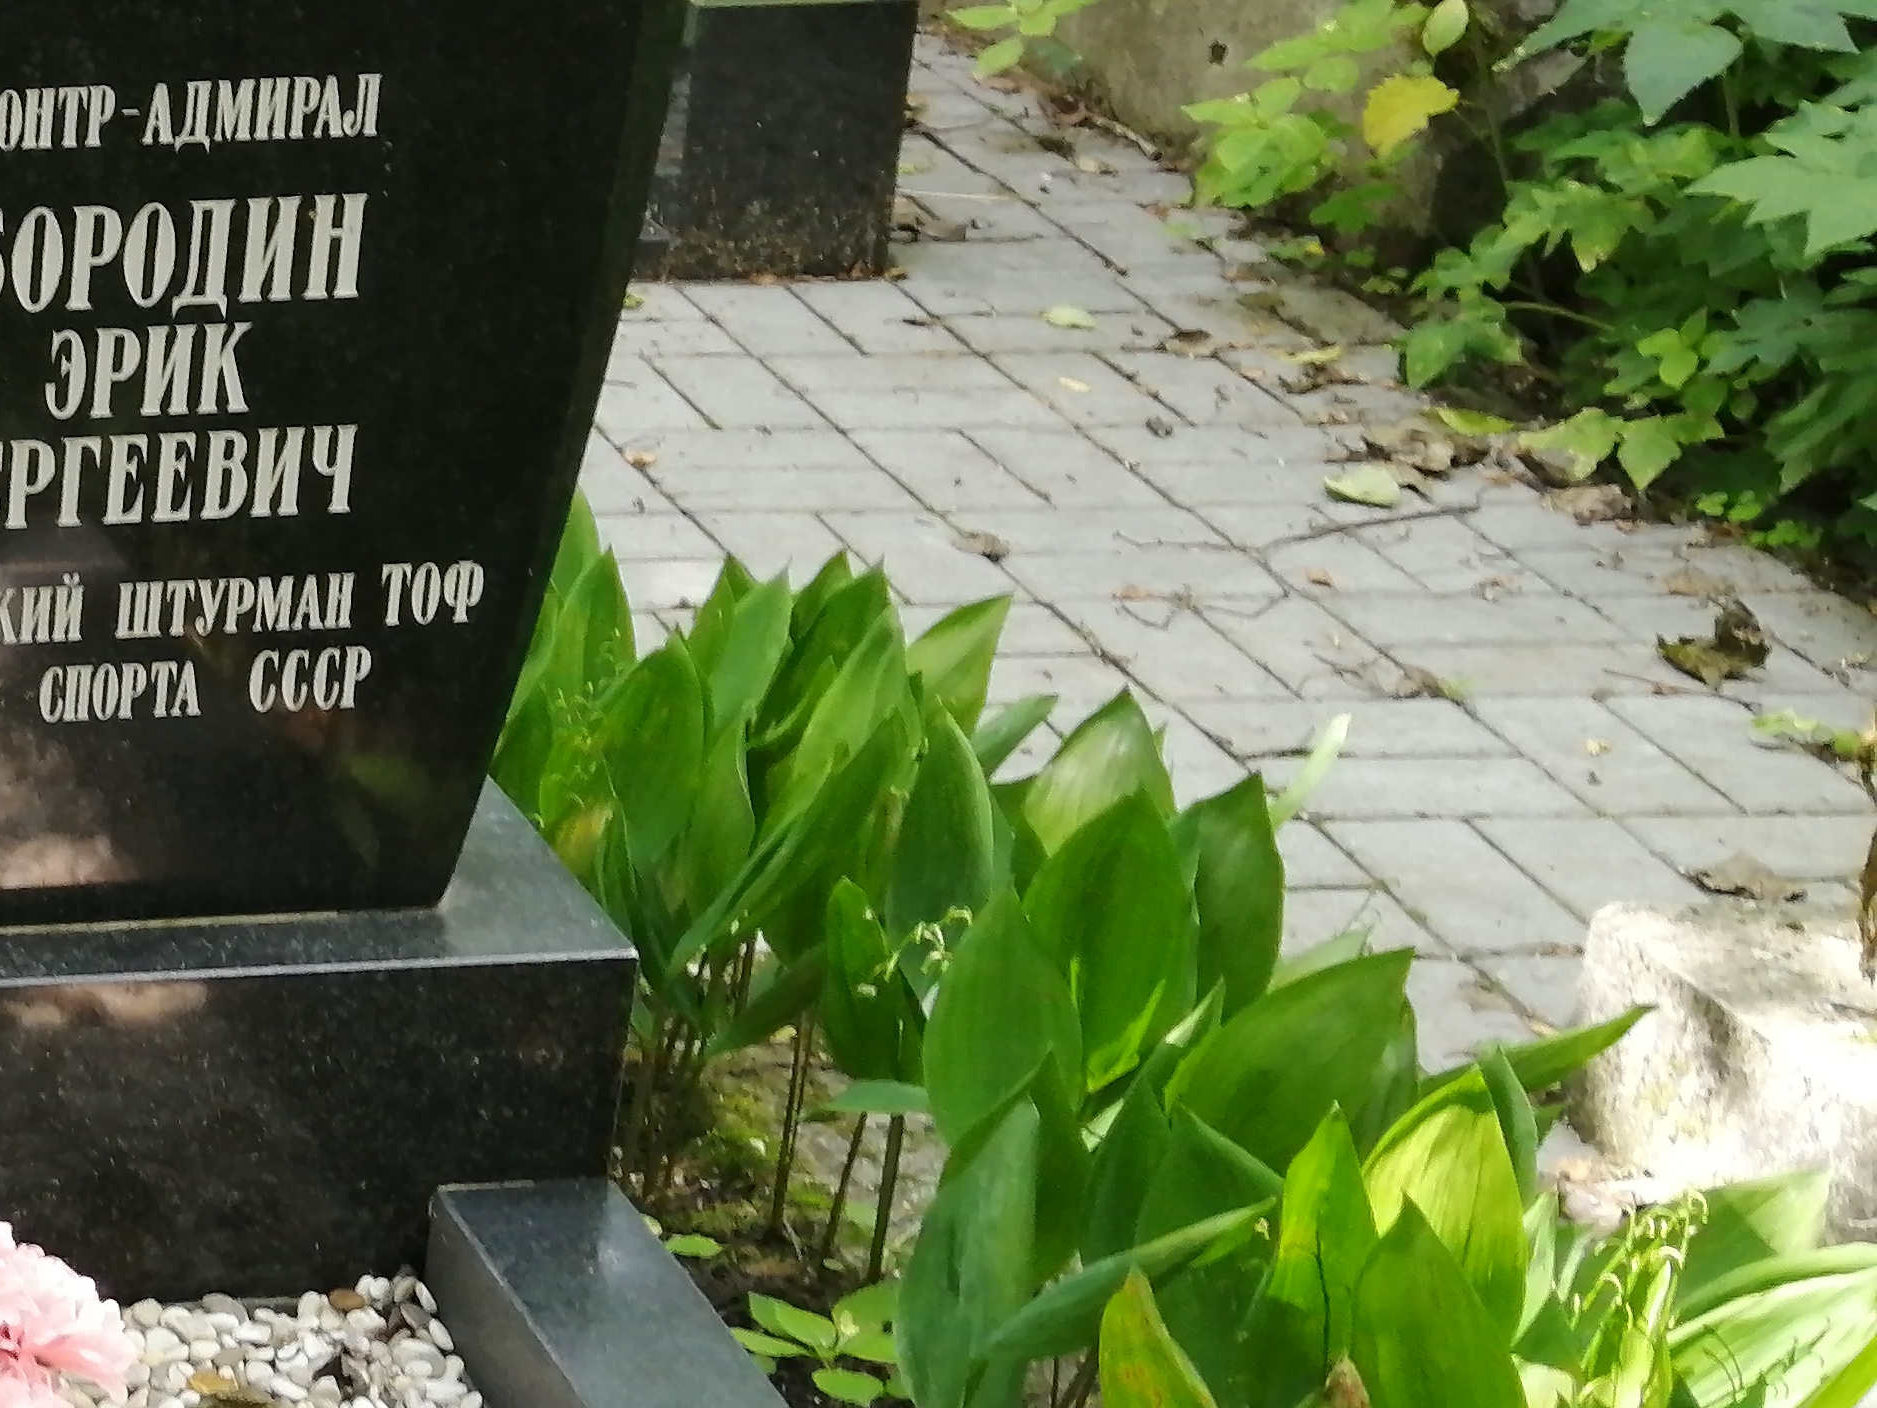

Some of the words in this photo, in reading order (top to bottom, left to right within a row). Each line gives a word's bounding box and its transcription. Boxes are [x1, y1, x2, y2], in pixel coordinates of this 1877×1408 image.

[44, 321, 253, 421] ЭРИК
[114, 571, 355, 640] ШТУРМАН
[381, 559, 485, 627] ТОФ
[38, 660, 202, 724] СПОРТА
[248, 645, 372, 713] СССР
